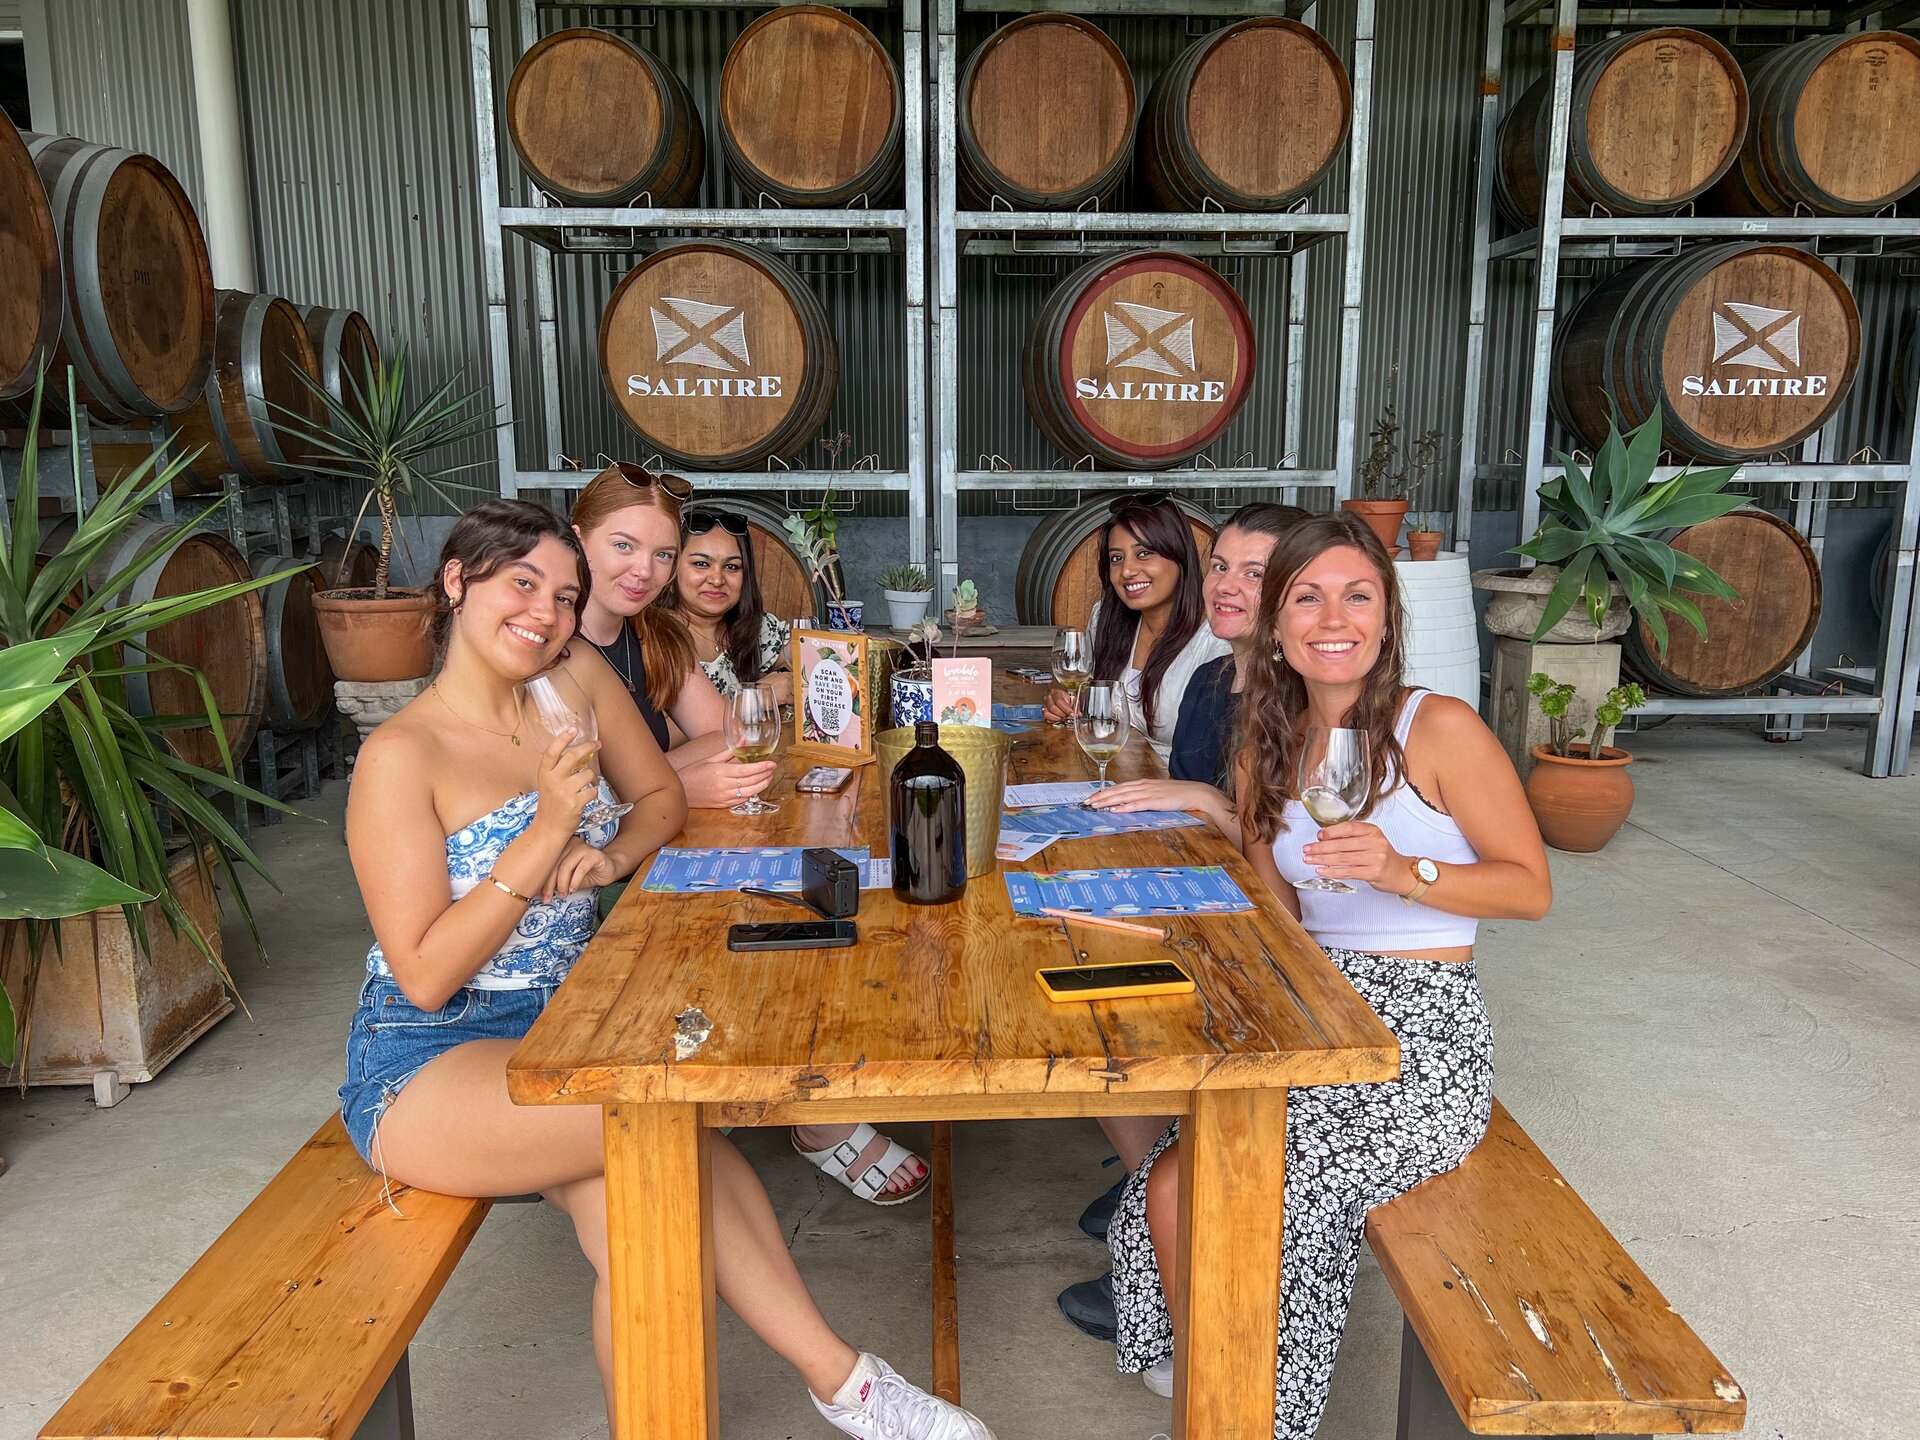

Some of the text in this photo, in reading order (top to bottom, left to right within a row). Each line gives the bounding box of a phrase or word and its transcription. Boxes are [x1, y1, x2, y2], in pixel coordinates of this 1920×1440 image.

[627, 374, 782, 397] SALTIRE
[1075, 377, 1225, 402] SALTIRE
[1681, 375, 1827, 397] SALTIRE
[814, 699, 846, 710] PURCHASE
[859, 1379, 871, 1396] NIKE
